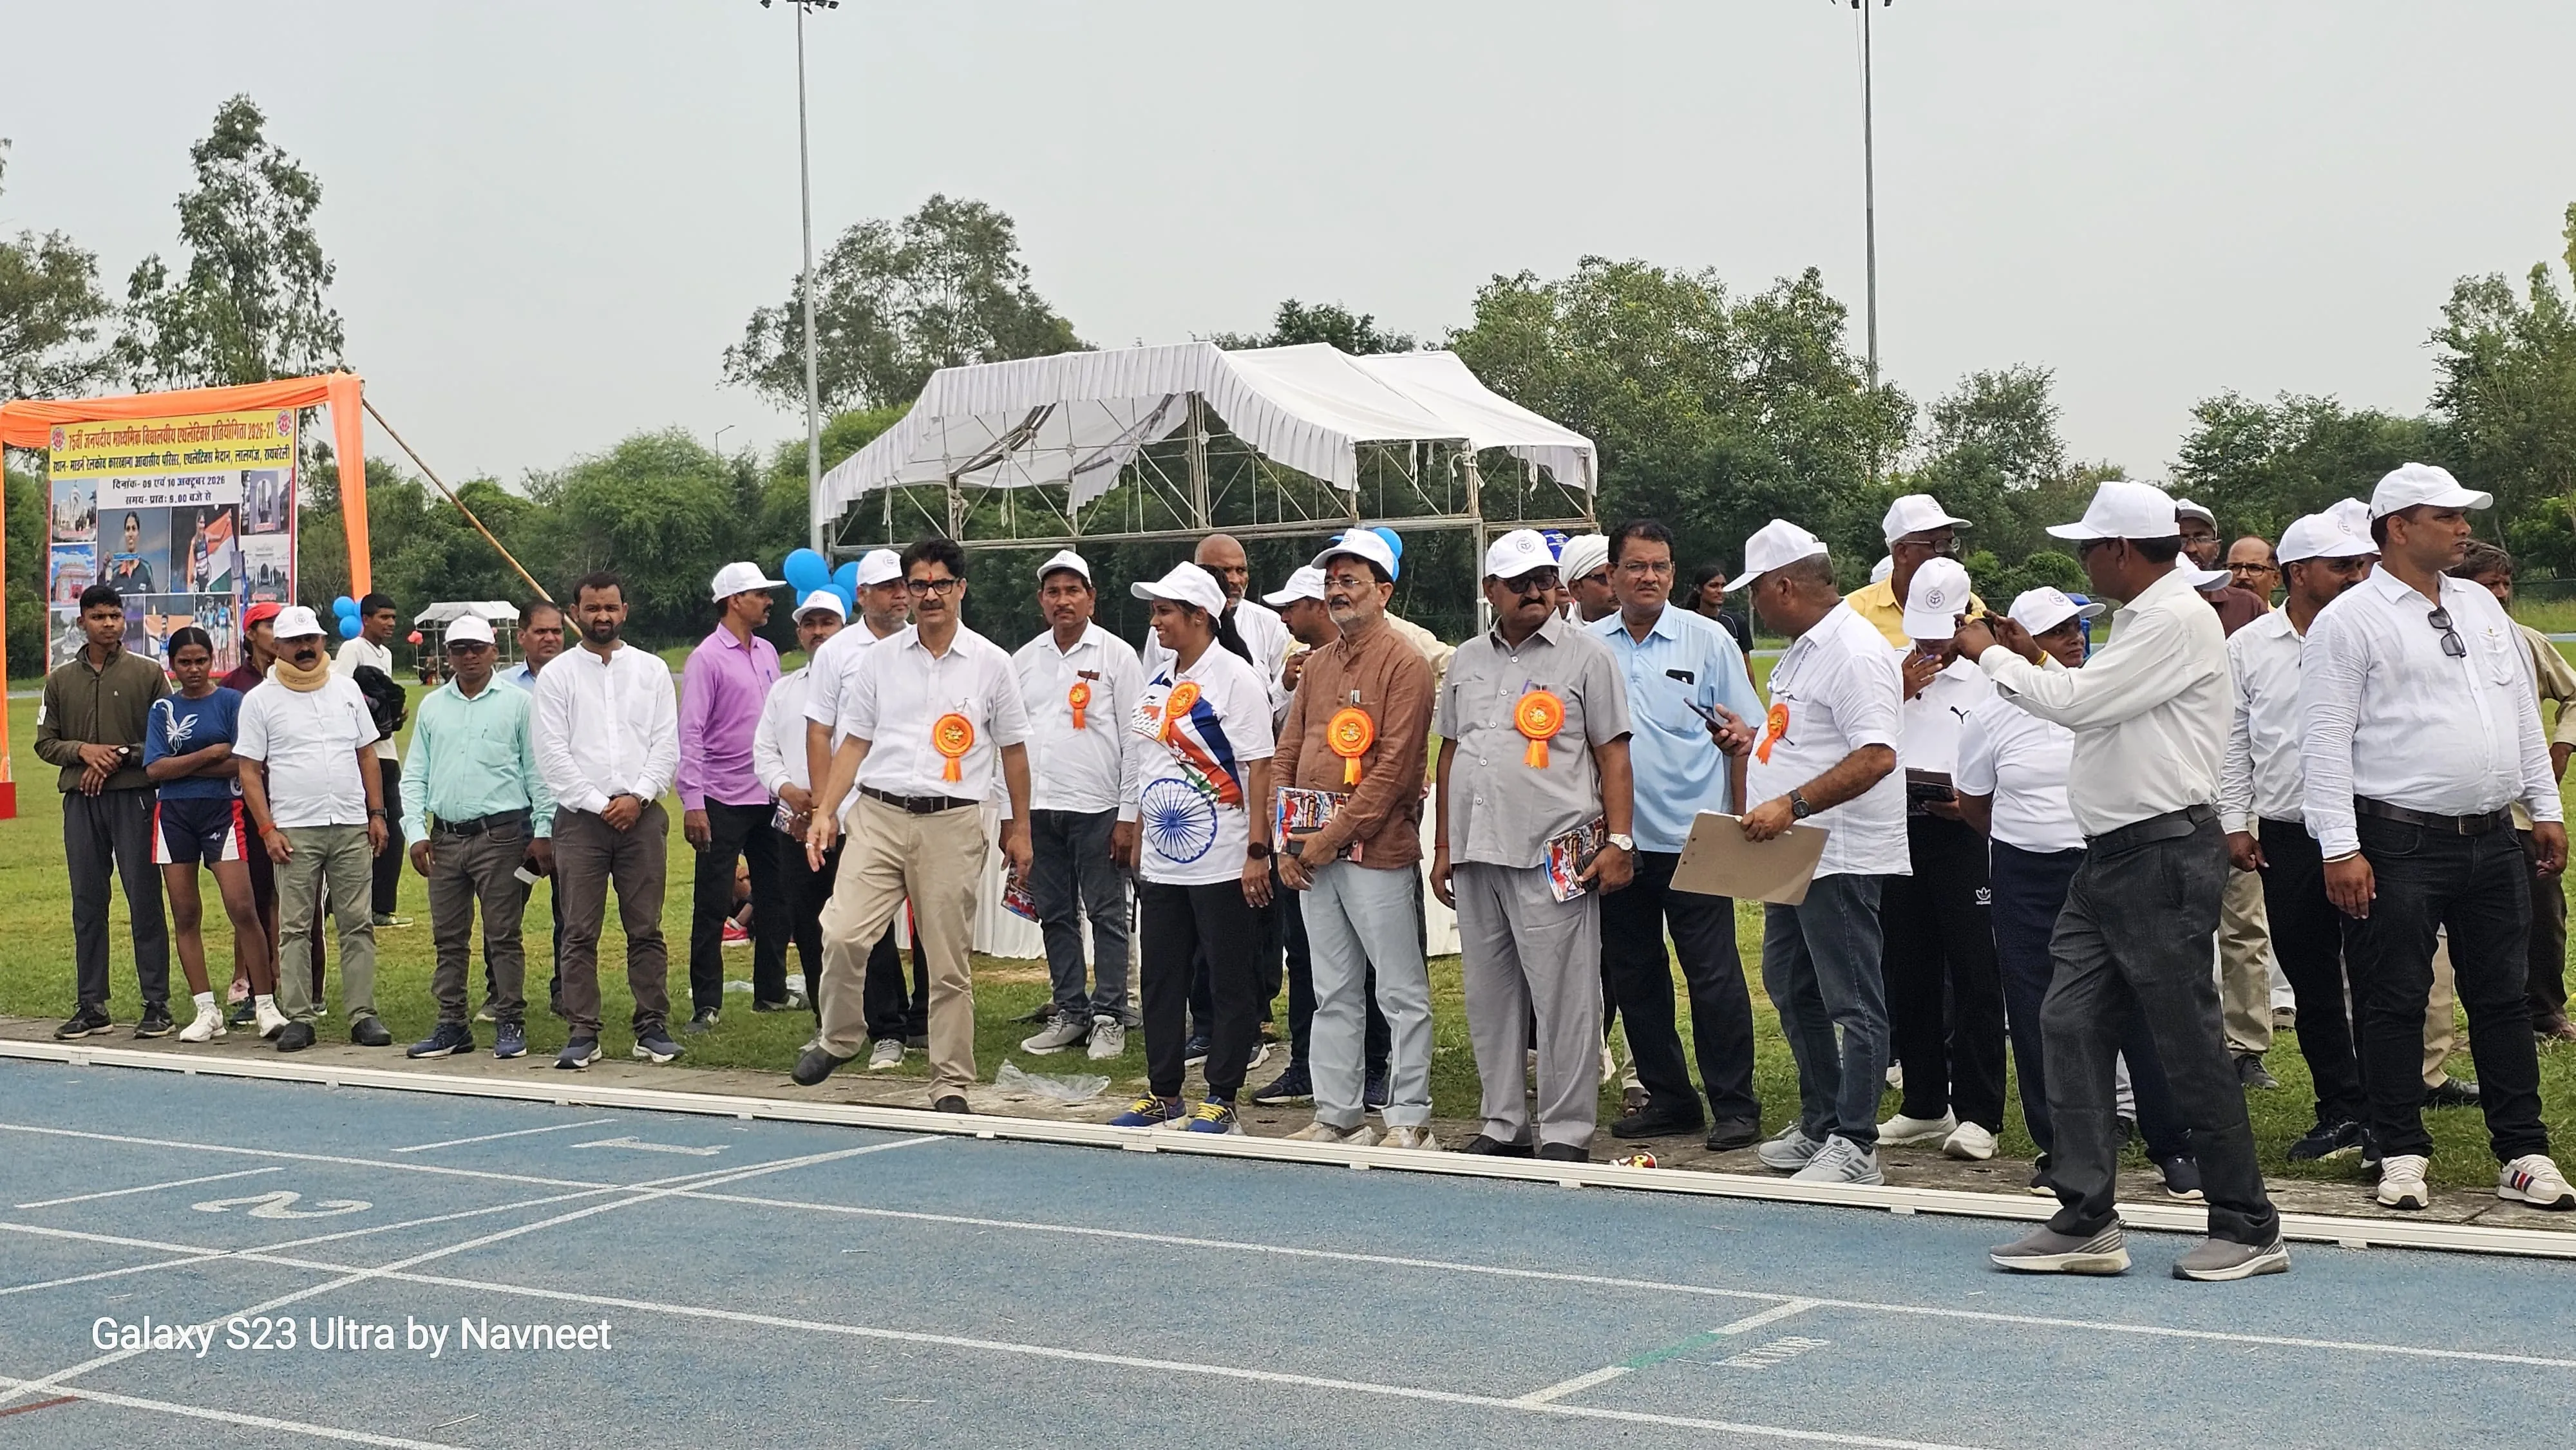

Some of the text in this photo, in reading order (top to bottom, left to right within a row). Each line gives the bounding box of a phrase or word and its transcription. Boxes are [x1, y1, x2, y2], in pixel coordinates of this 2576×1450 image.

[84, 428, 111, 449] जनपदीय
[113, 425, 142, 447] माध्यमिक
[212, 419, 247, 442] प्रतियोगिता
[108, 456, 133, 469] कारखाना
[135, 451, 160, 467] आवासीय
[142, 479, 152, 489] 09
[154, 476, 166, 488] एवं
[167, 478, 175, 488] 10
[207, 475, 225, 485] 2026
[169, 493, 187, 504] 9.00
[189, 490, 203, 502] बजे
[205, 489, 211, 501] से
[191, 1190, 374, 1219] 2
